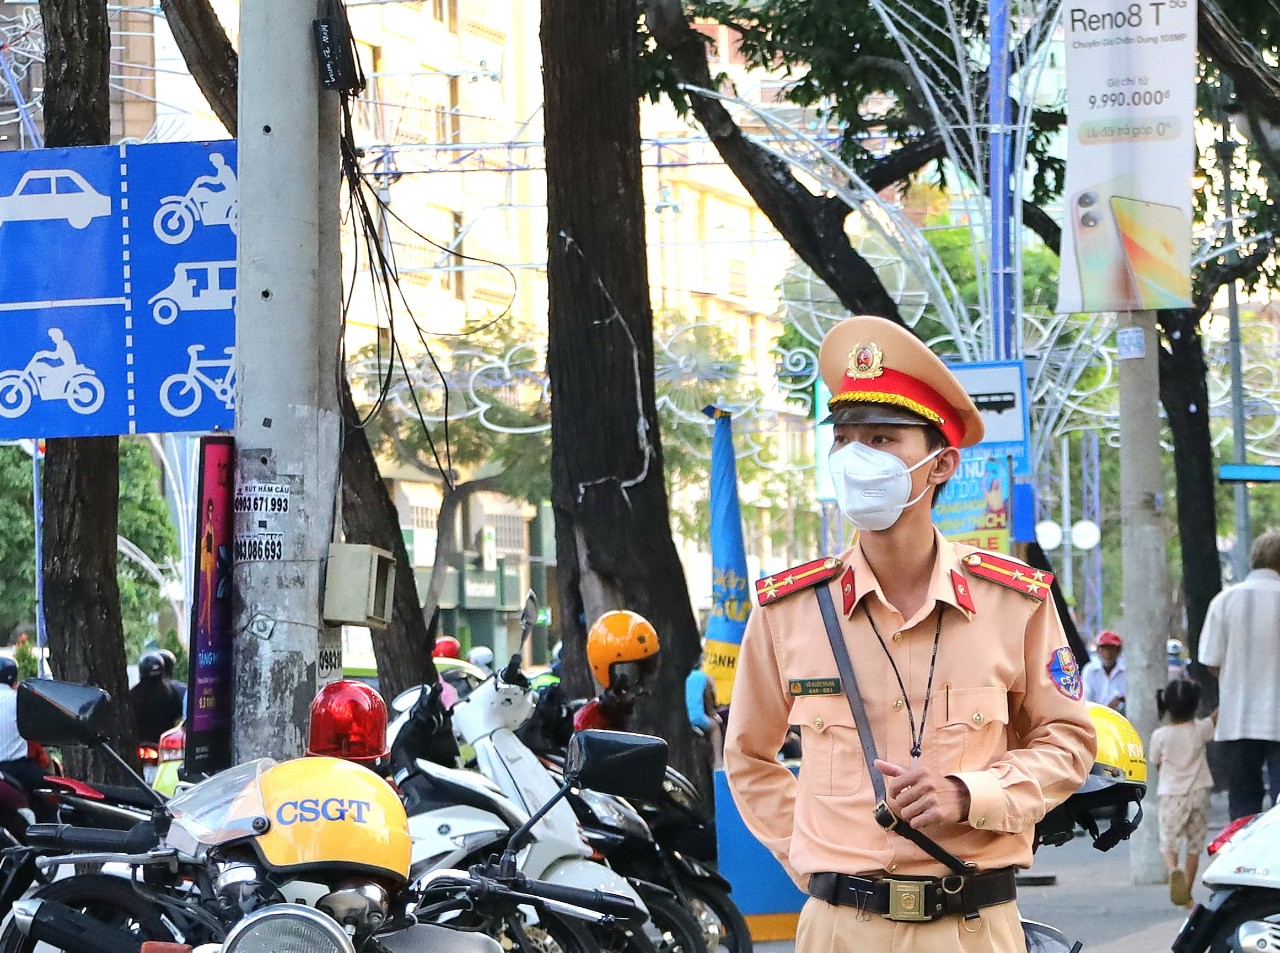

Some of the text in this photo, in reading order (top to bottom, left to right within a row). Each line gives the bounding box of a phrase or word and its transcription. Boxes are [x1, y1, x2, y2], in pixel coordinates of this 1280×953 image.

[1070, 3, 1142, 32] Reno8
[1149, 2, 1165, 26] T
[276, 797, 371, 826] CSGT
